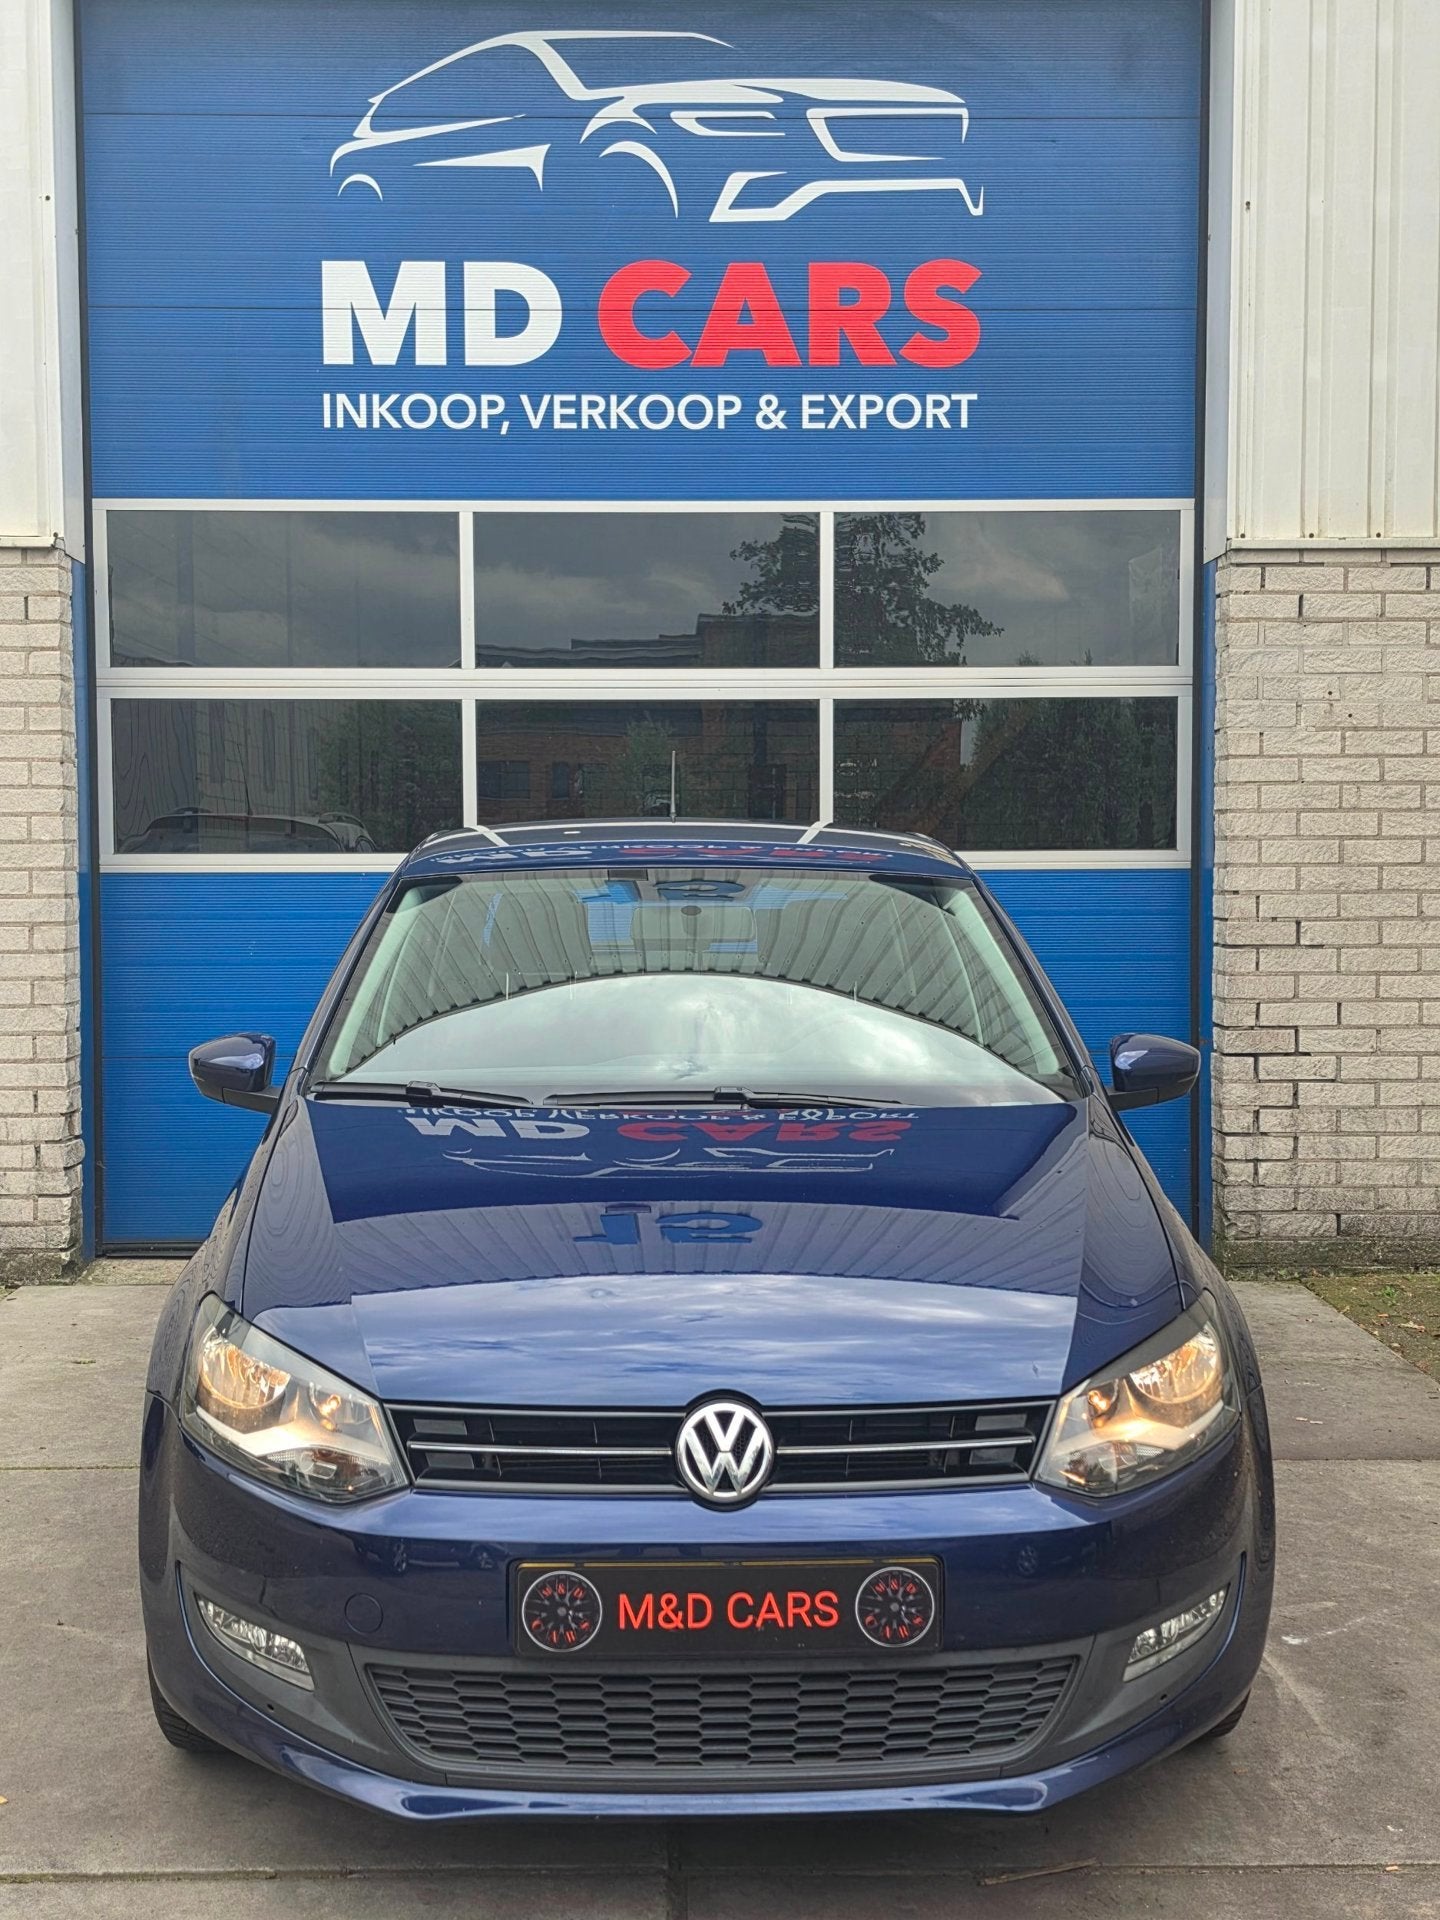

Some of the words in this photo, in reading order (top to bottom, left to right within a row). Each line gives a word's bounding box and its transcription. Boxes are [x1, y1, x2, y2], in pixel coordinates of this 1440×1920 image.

[321, 260, 563, 366] MD
[598, 259, 982, 370] CARS
[323, 393, 510, 435] INKOOP,
[519, 394, 742, 430] VERKOOP
[755, 394, 787, 430] &
[801, 393, 978, 430] EXPORT
[617, 1592, 712, 1630] M&D
[727, 1590, 840, 1629] CARS
